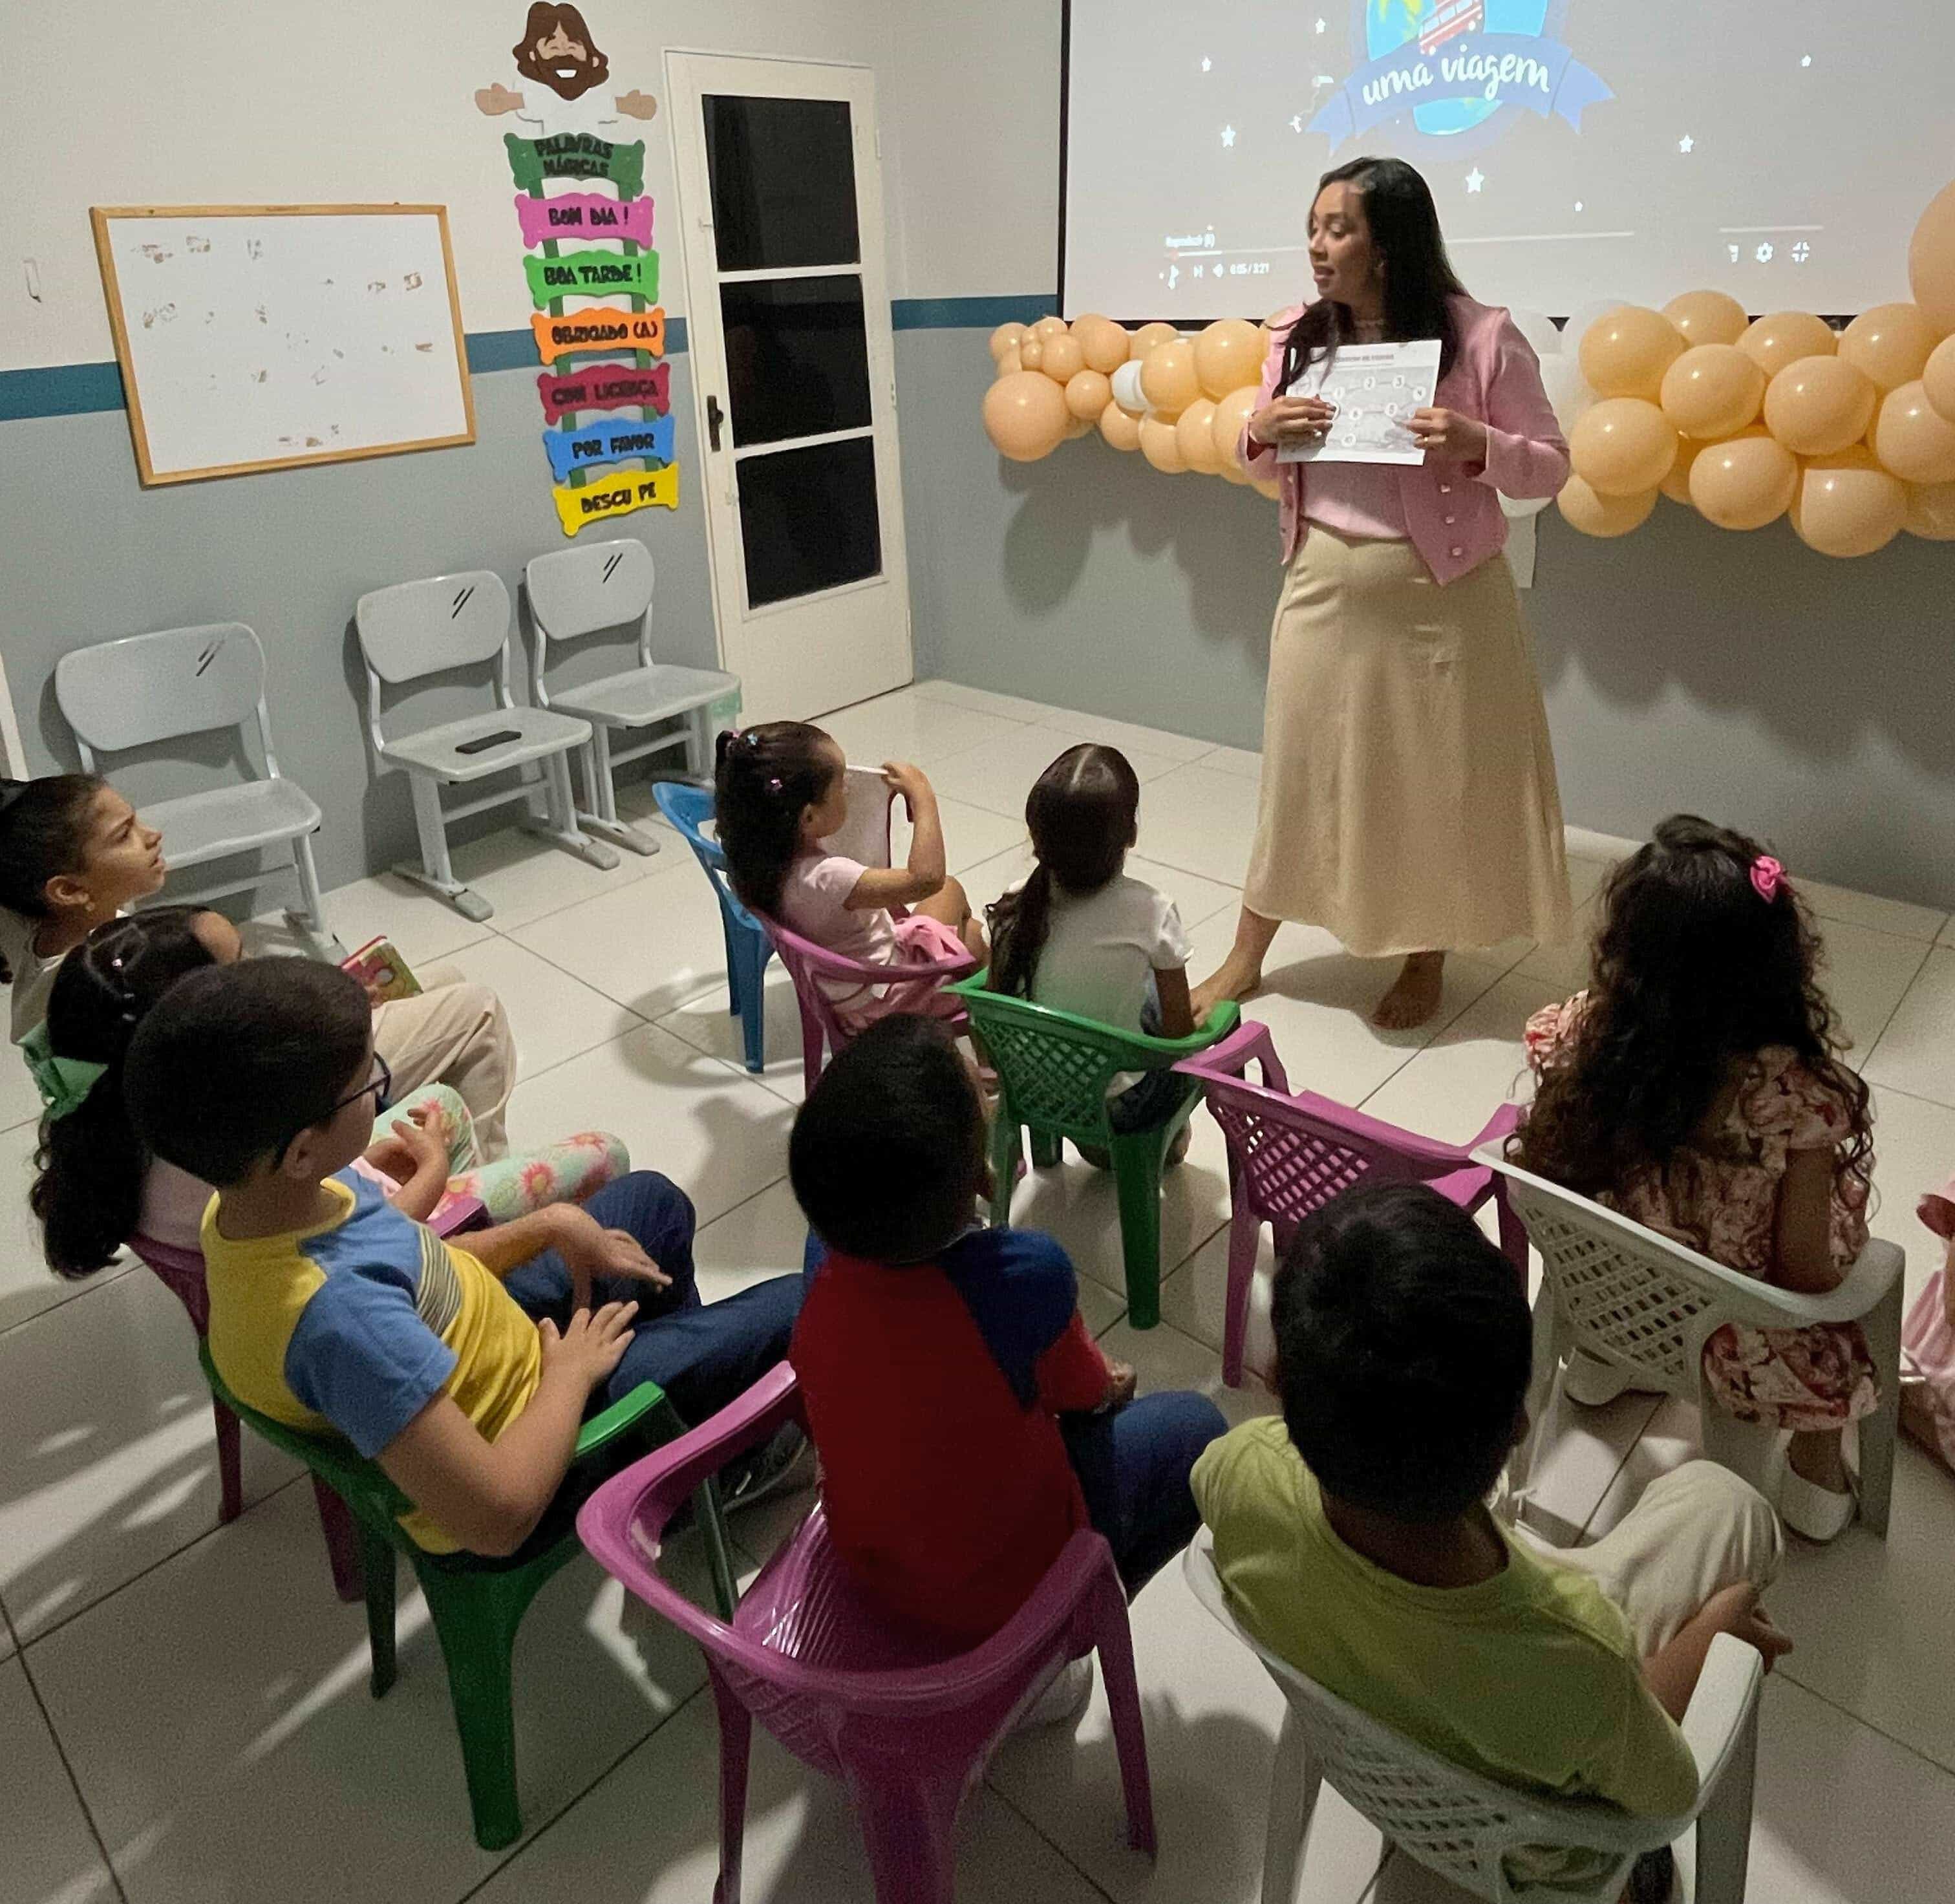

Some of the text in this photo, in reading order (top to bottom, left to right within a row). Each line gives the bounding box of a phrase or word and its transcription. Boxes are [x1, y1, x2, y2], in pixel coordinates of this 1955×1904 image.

[1362, 44, 1552, 105] uma viagem
[548, 207, 583, 226] BOM
[544, 266, 578, 286] BOA
[551, 321, 658, 345] OBRIGADO (A)
[551, 386, 586, 405] COM
[572, 433, 655, 459] POR FAVOR
